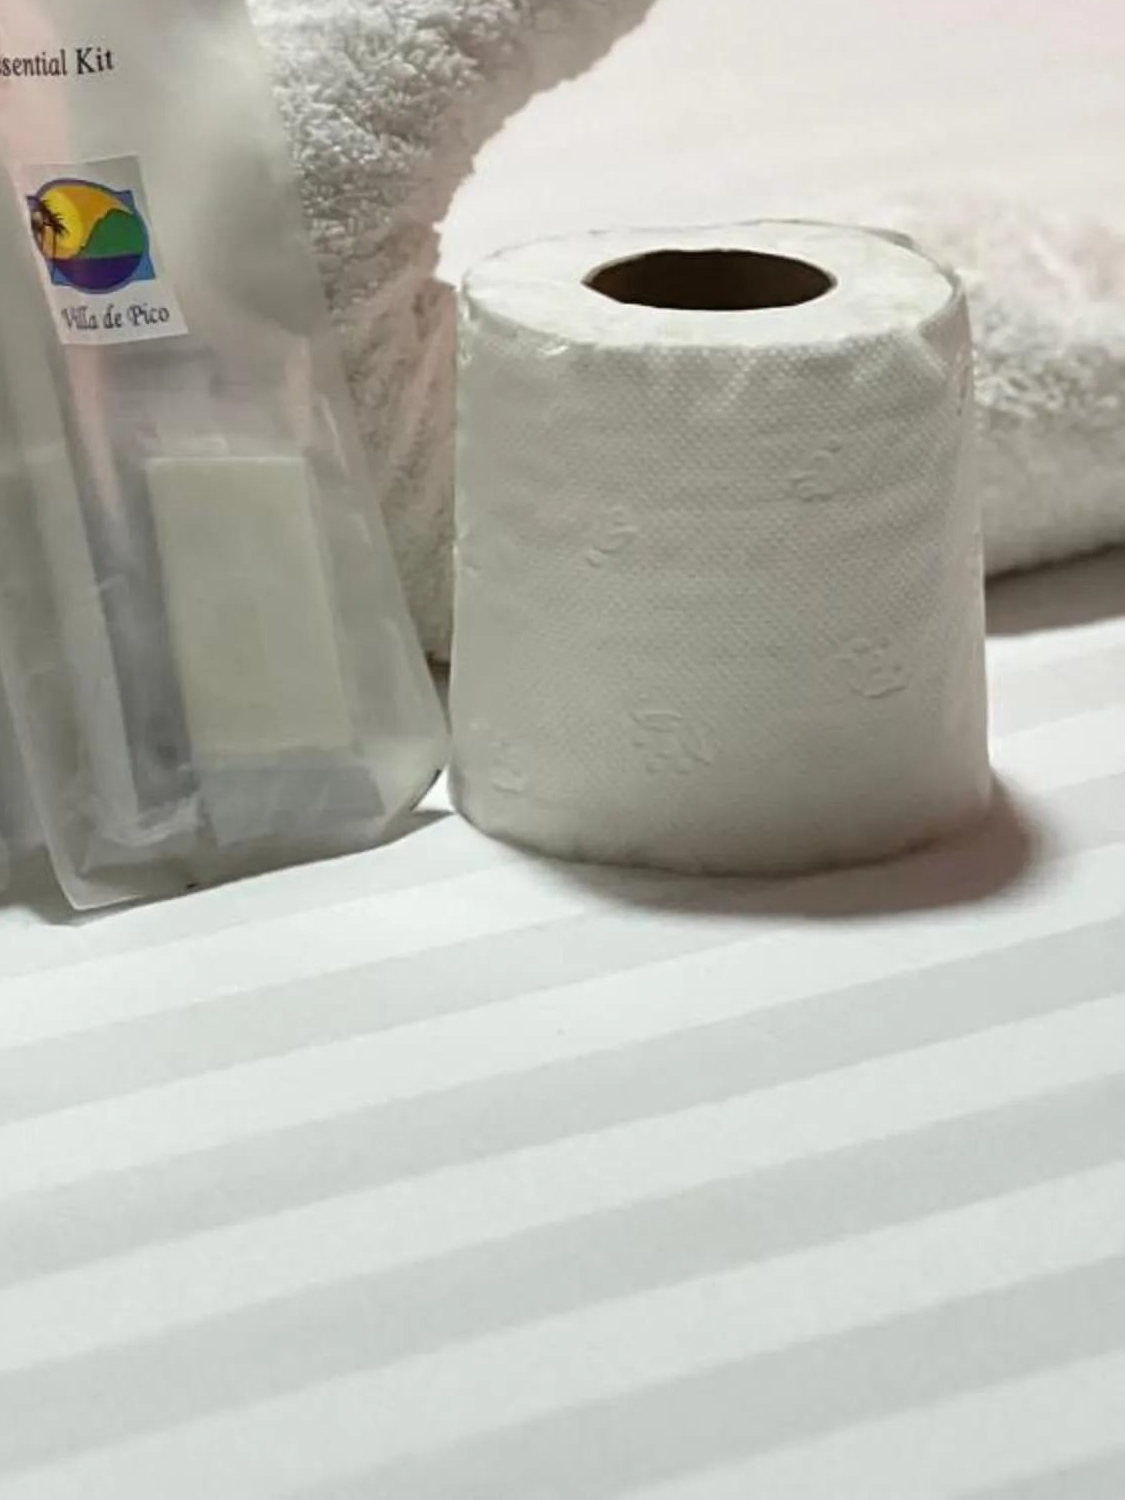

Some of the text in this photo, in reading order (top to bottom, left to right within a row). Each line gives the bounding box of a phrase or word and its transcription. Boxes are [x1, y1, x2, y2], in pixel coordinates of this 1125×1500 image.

[76, 46, 115, 75] Kit
[61, 303, 170, 330] Villa de Pico
